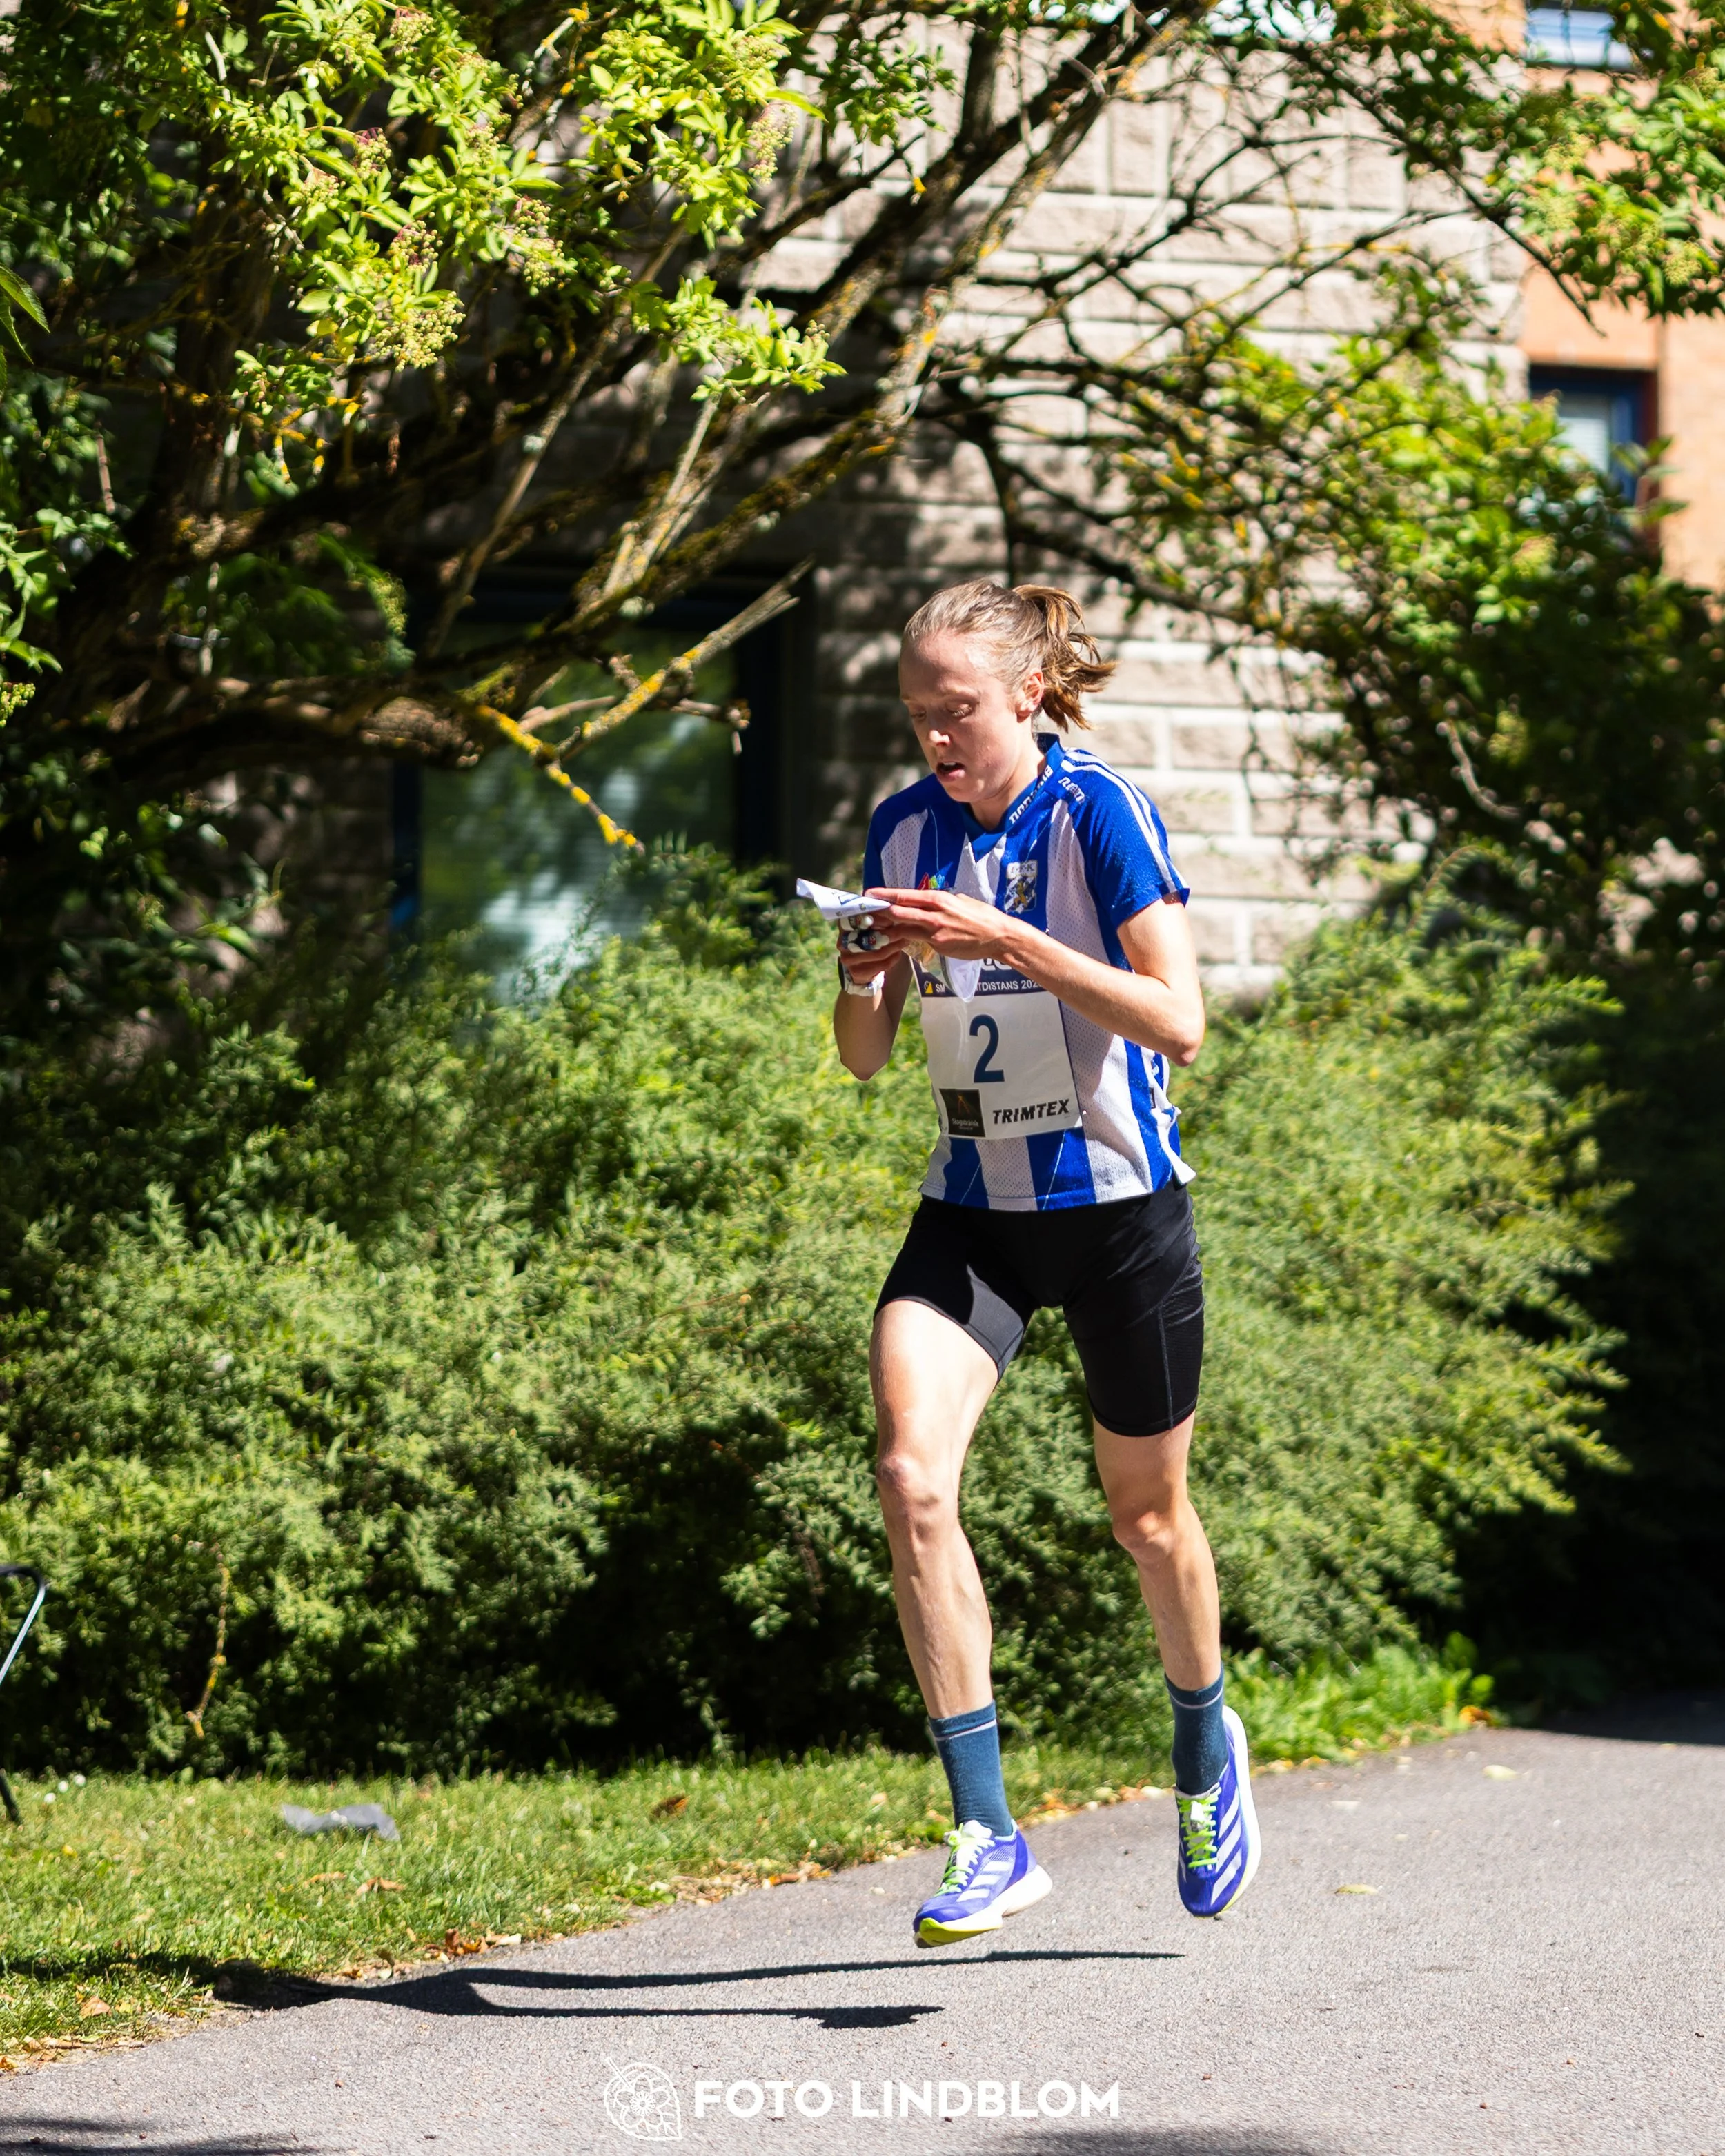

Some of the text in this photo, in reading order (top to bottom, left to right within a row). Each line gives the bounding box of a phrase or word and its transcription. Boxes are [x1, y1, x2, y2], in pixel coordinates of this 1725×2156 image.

[936, 983, 945, 993] SM
[1021, 979, 1044, 989] 202
[969, 1013, 1005, 1083] 2
[992, 1098, 1070, 1125] TRIMTEX
